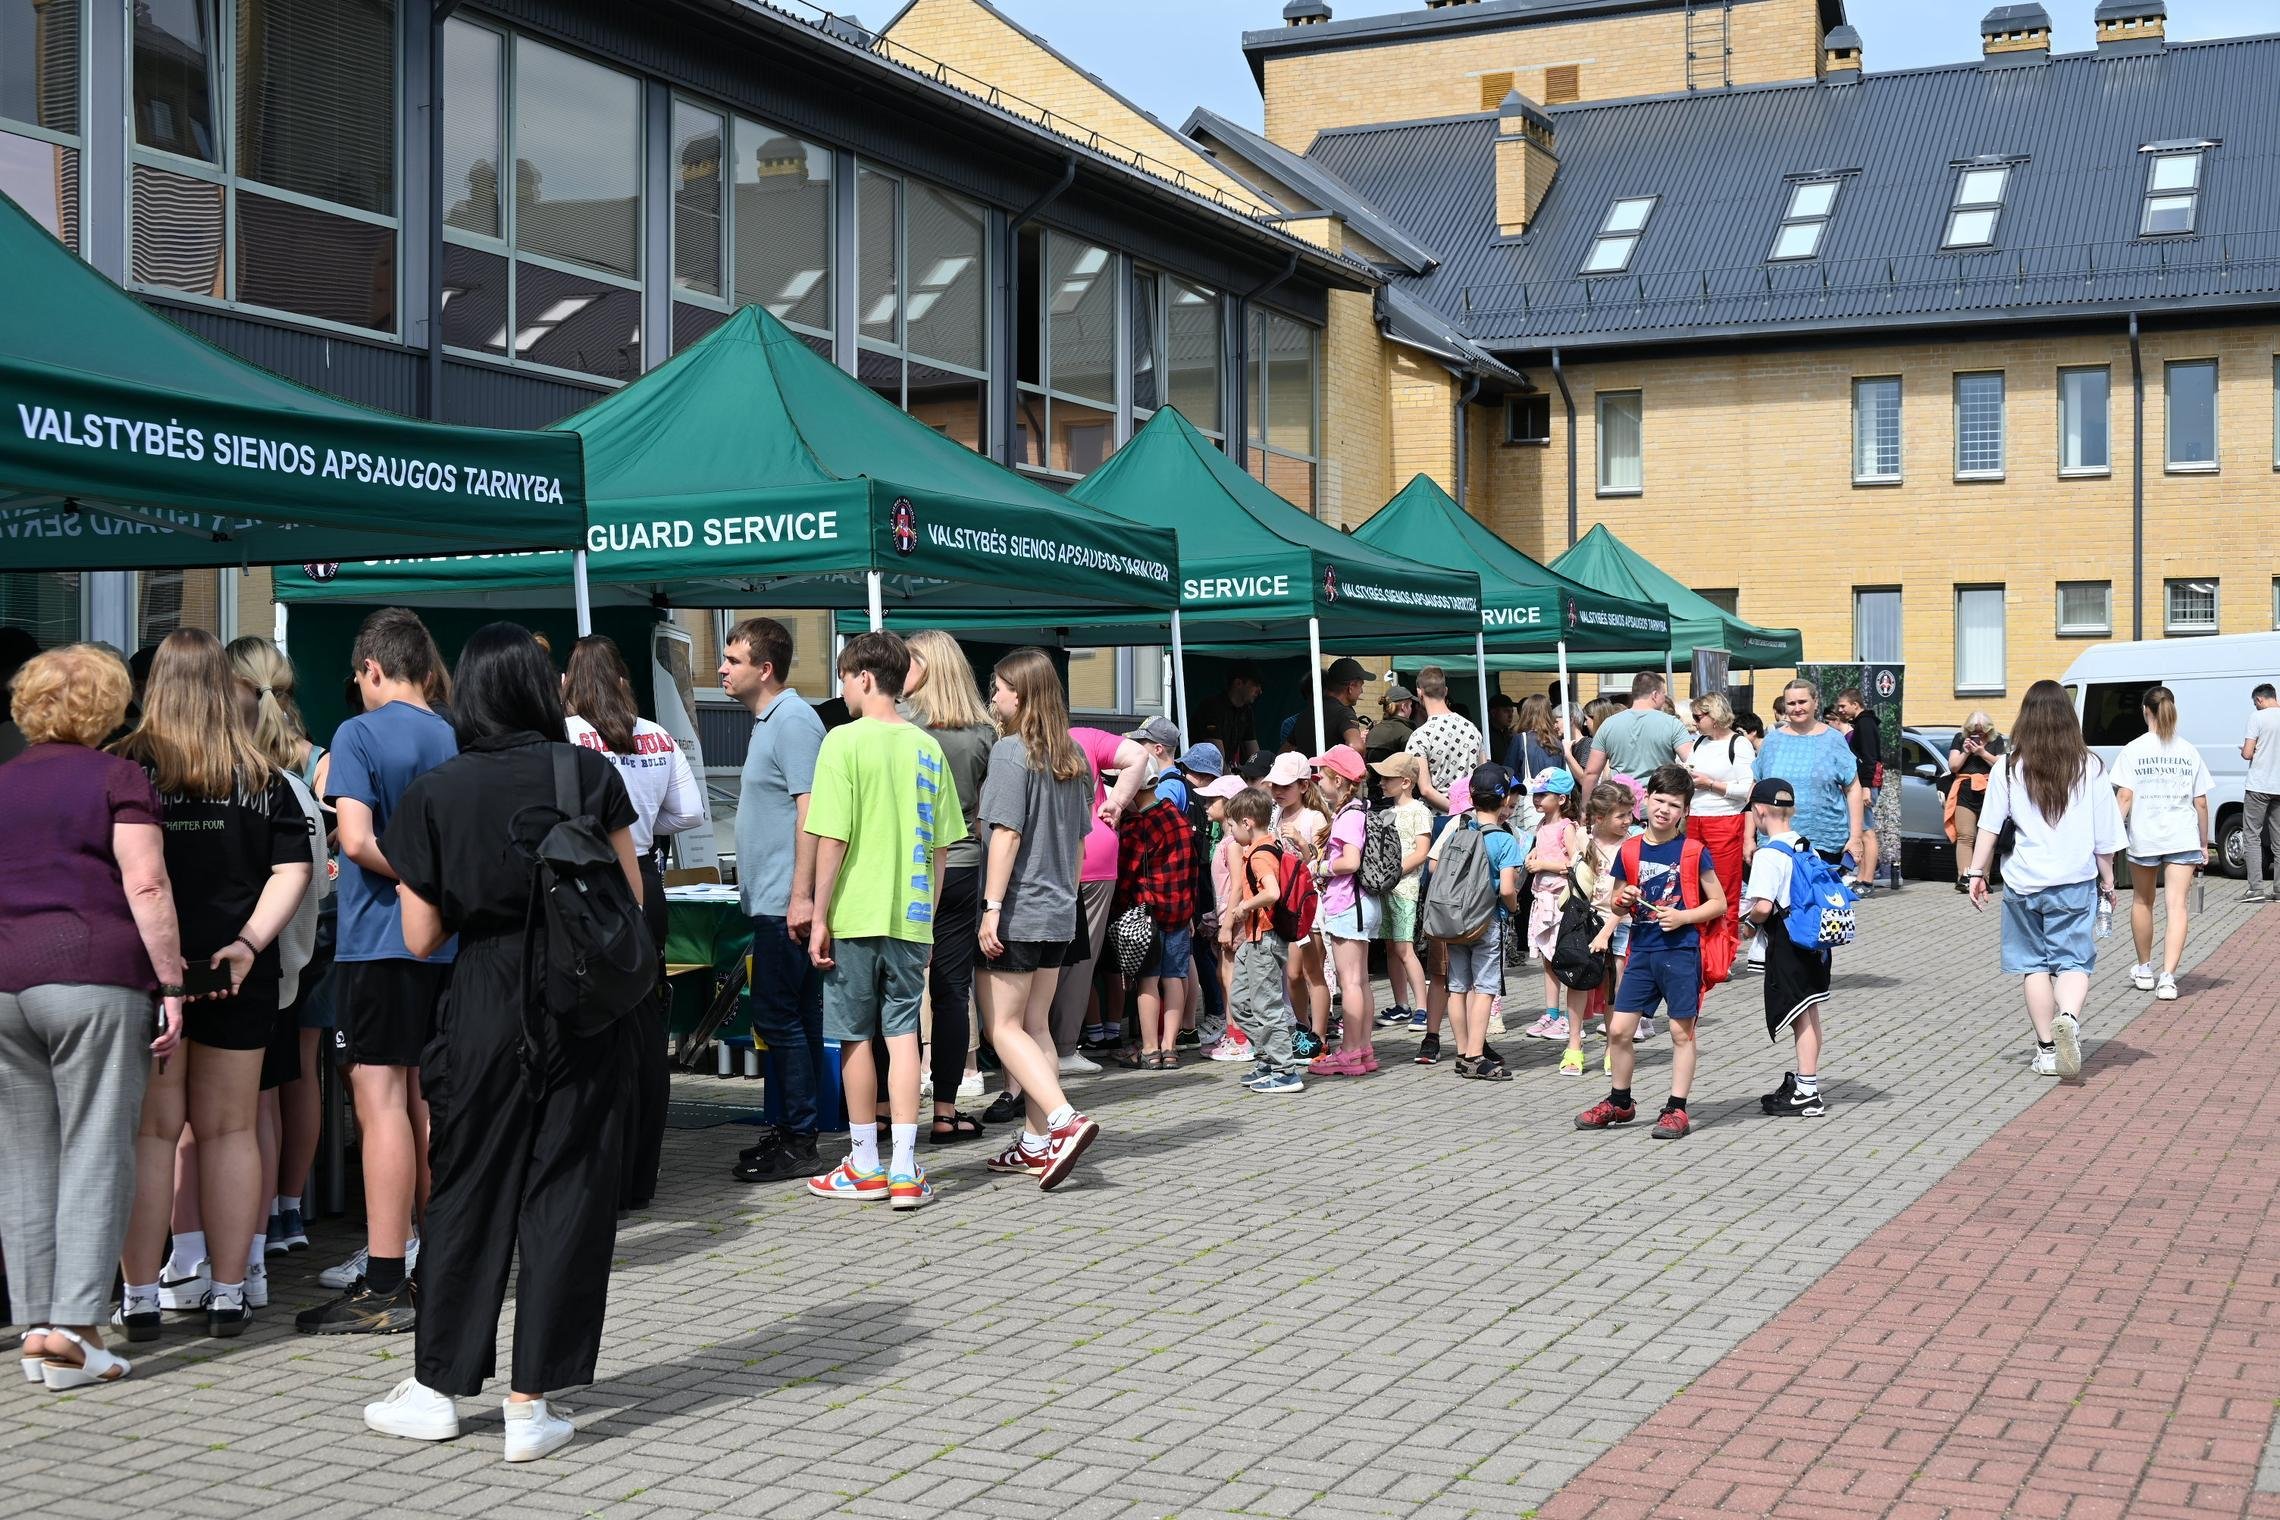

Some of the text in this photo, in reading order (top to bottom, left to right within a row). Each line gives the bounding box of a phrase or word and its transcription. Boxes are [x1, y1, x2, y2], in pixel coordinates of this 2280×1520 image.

[18, 404, 564, 504] VALSTYBĖS SIENOS APSAUGOS TARNYBA
[587, 511, 838, 552] GUARD SERVICE
[927, 523, 1007, 555] VALSTYBĖS
[1010, 535, 1056, 562] SIENOS
[1058, 543, 1121, 573] APSAUGOS
[1120, 555, 1169, 582] TARNYBA
[1183, 575, 1289, 600] SERVICE
[1481, 606, 1541, 625] RVICE
[641, 757, 667, 768] RULES
[203, 820, 225, 830] FOUR
